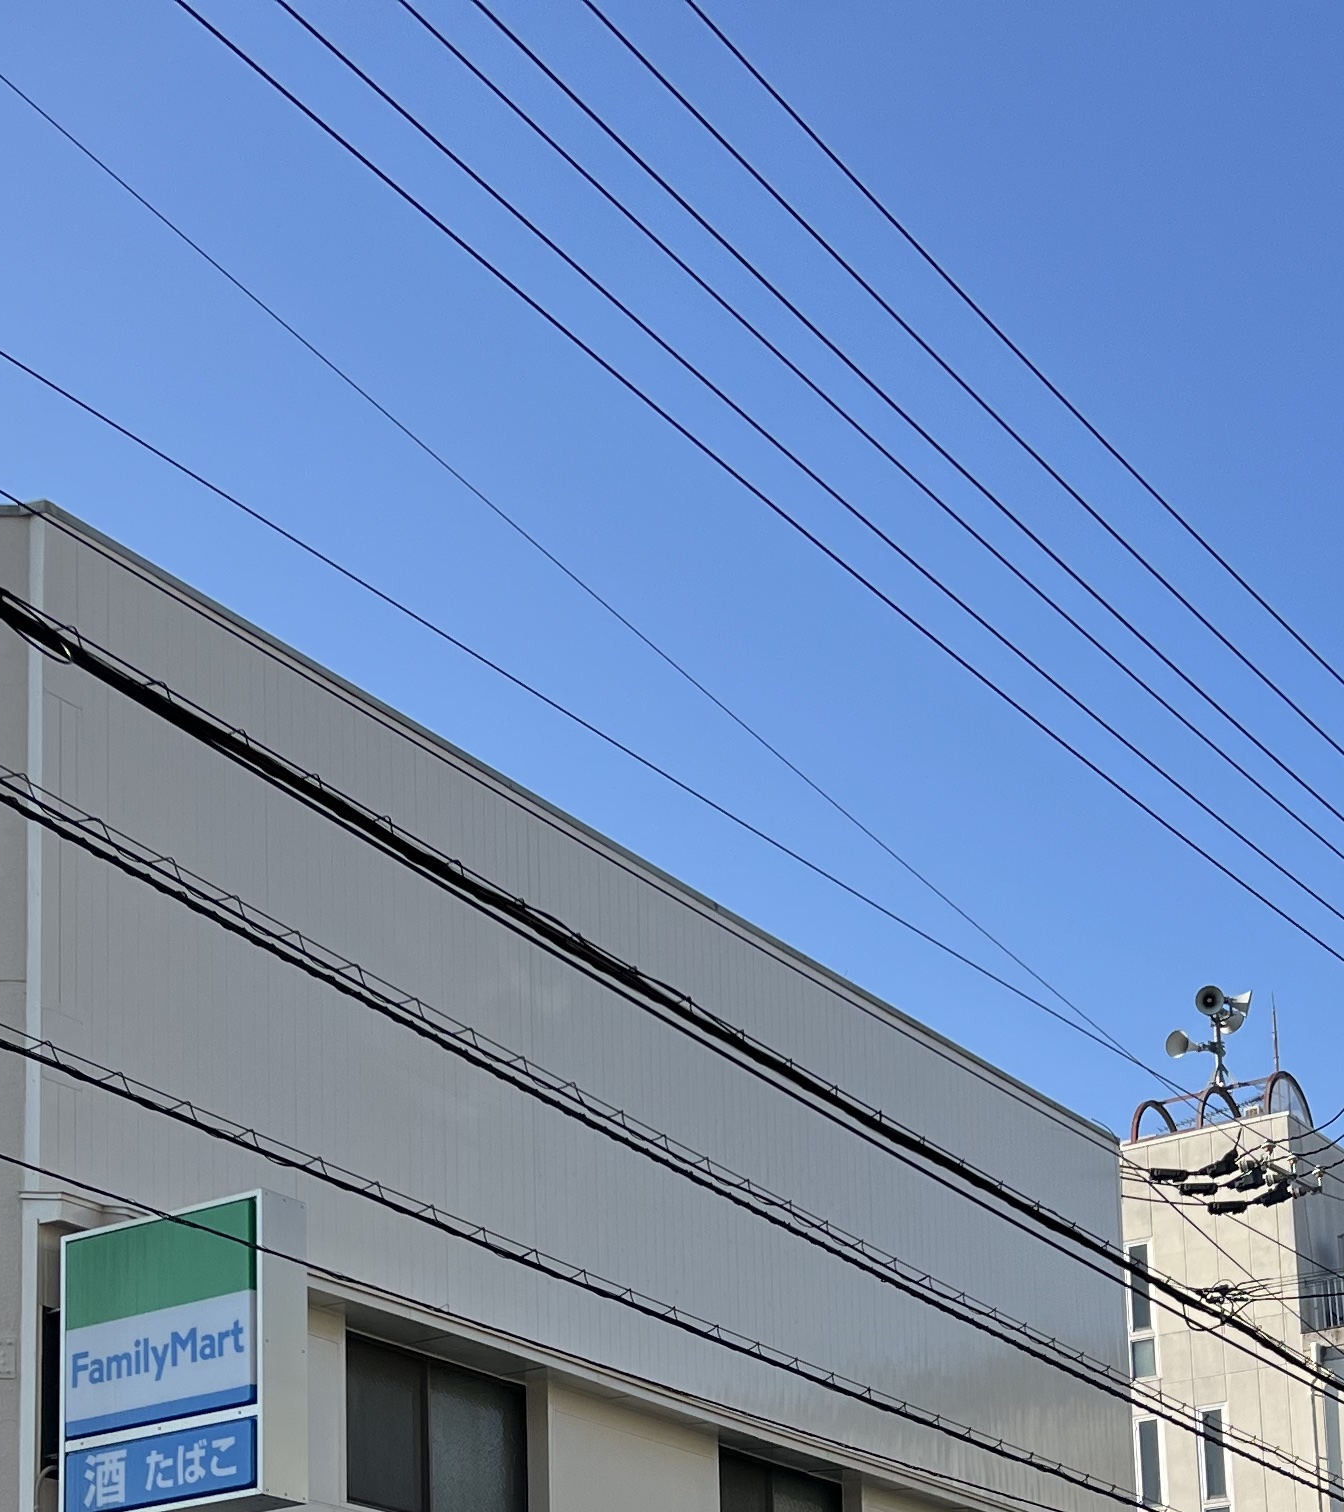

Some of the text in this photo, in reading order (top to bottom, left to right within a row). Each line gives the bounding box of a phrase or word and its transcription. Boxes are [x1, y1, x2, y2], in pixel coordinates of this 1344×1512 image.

[70, 1318, 247, 1390] FamilyMart
[83, 1435, 239, 1508] 酒 たばこ
